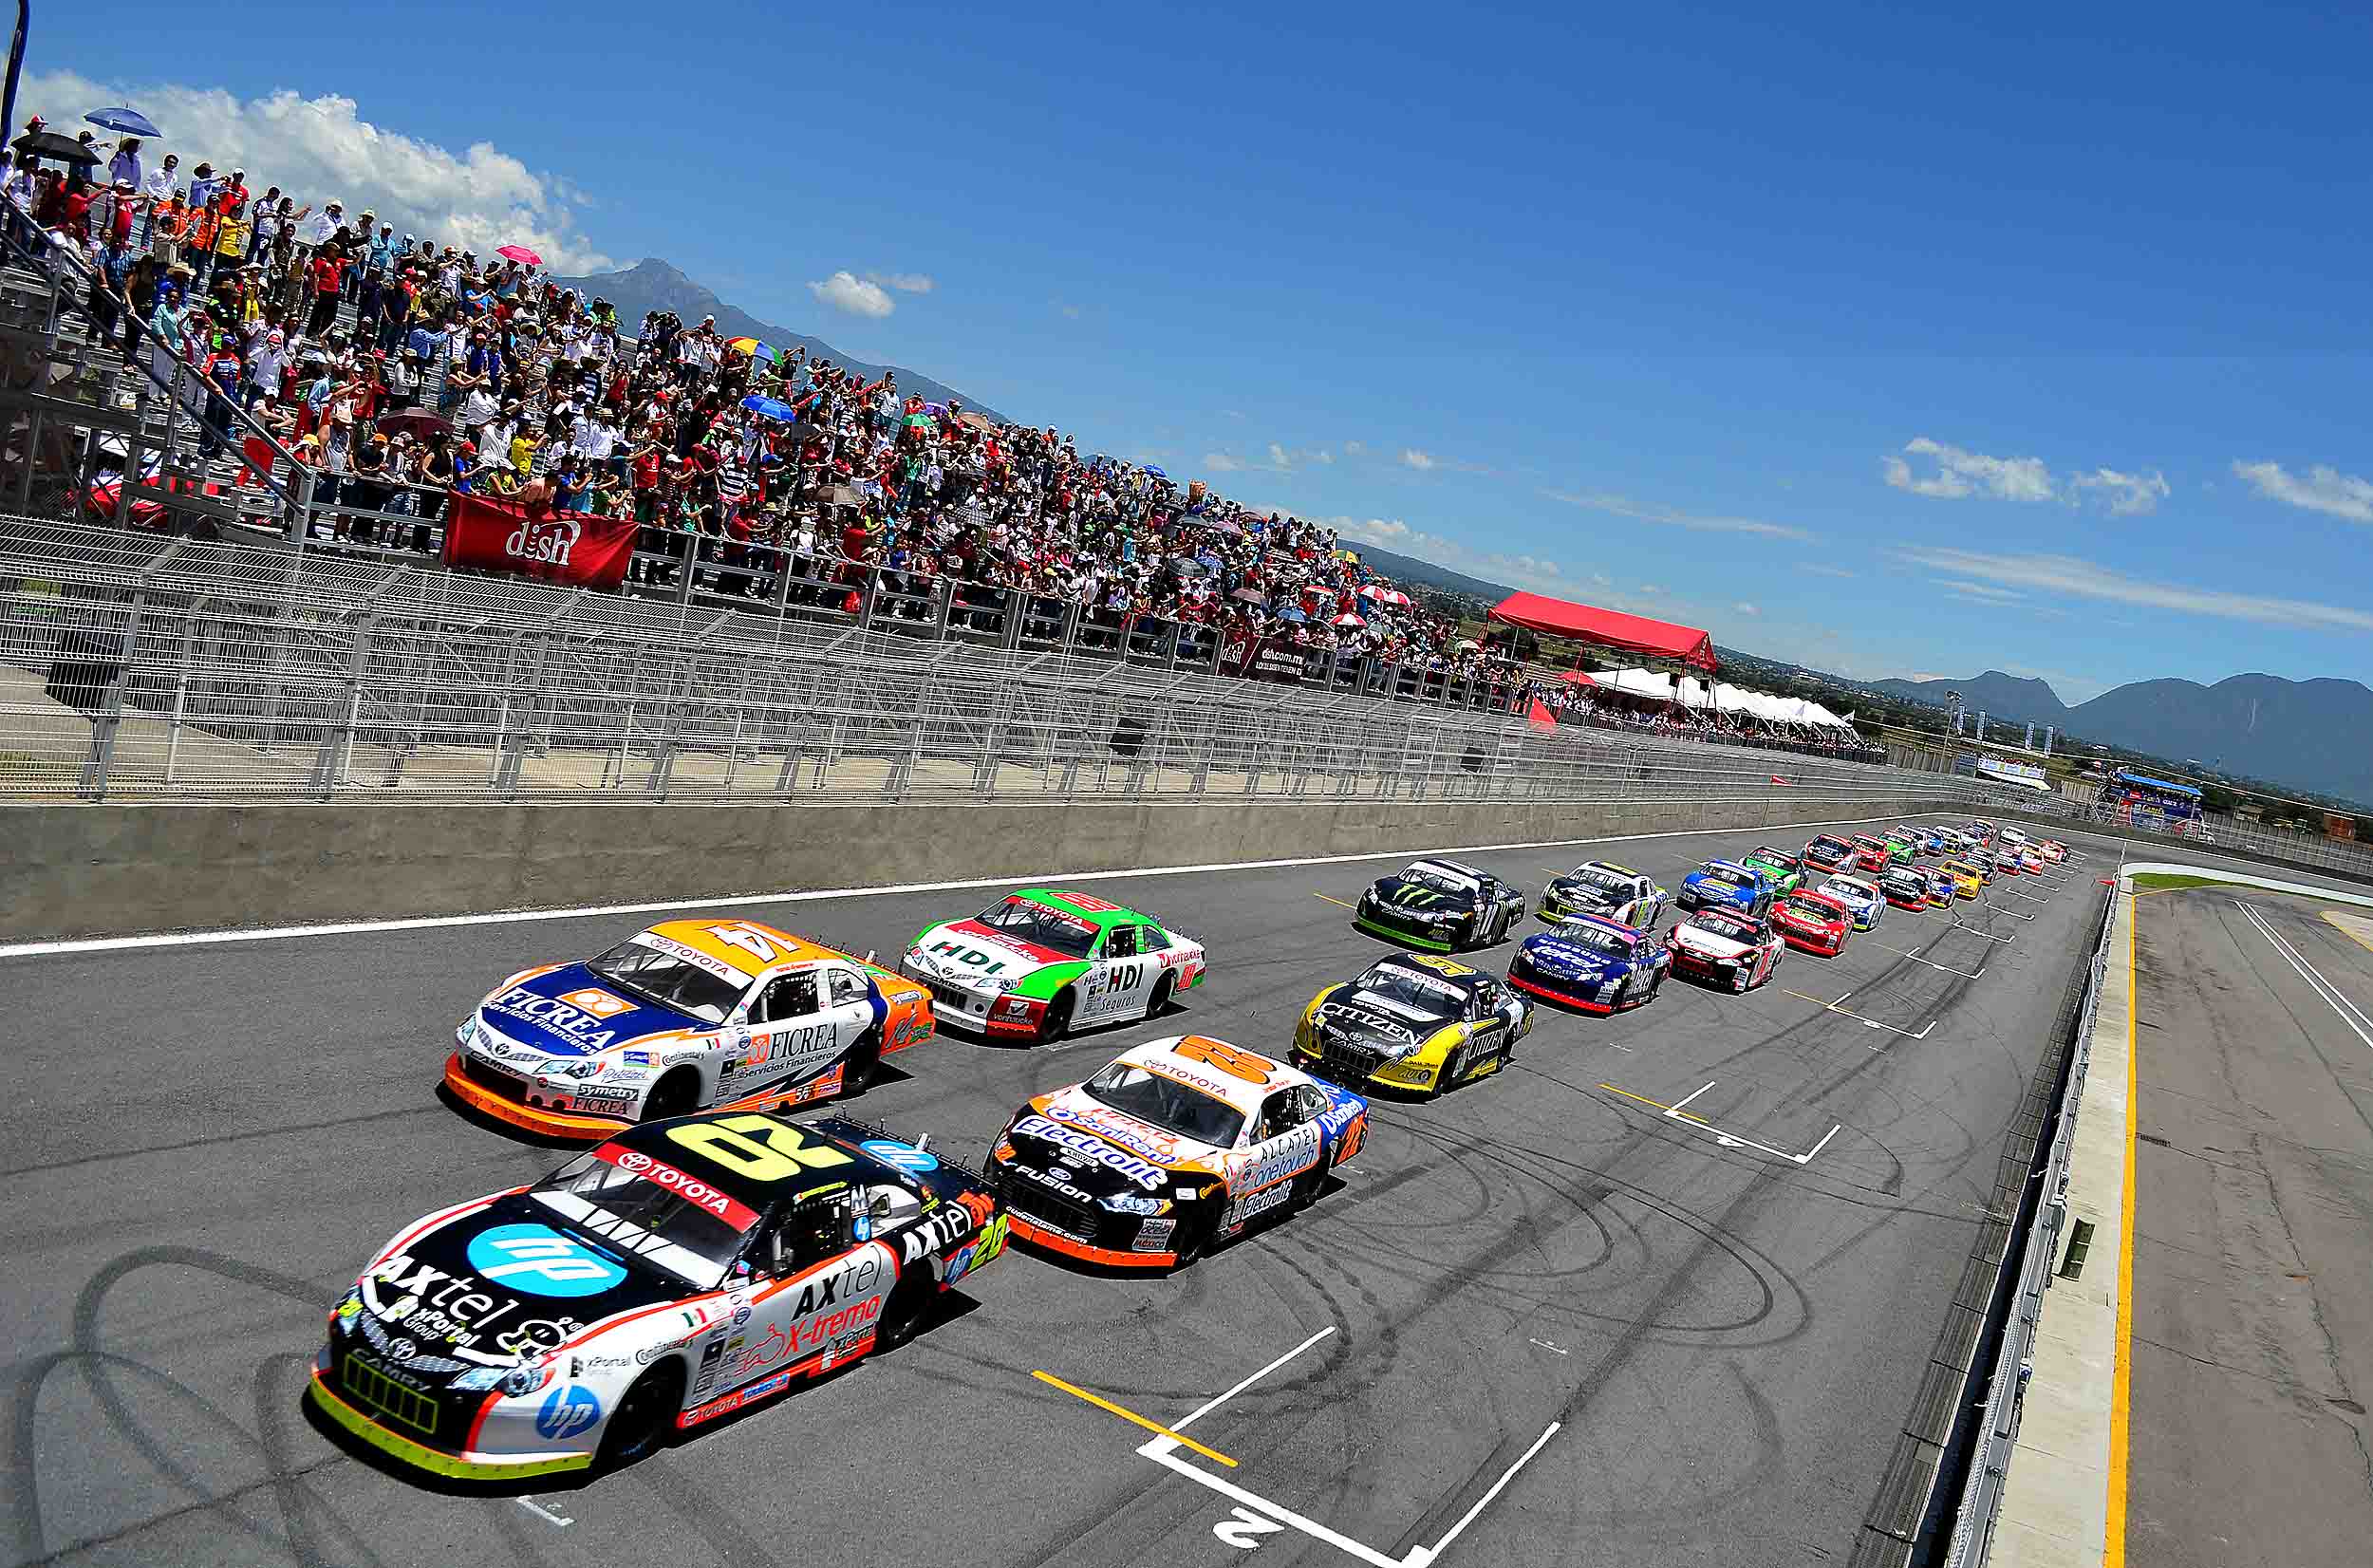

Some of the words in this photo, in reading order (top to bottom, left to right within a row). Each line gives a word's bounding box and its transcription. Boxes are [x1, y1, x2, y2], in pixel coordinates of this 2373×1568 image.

[505, 520, 582, 566] dish
[1037, 903, 1084, 925] TOYOTA
[670, 944, 730, 977] TOYOTA
[928, 941, 1007, 975] HDI
[1106, 963, 1145, 994] HDI
[1408, 970, 1452, 993] TOYOTA
[493, 985, 616, 1050] FICREA
[1100, 996, 1135, 1014] Seguros
[483, 1000, 538, 1025] Servicios
[533, 1017, 602, 1056] Financieros
[768, 1020, 838, 1061] FICREA
[1320, 1001, 1426, 1046] CITIZEN
[1329, 1036, 1375, 1055] CAMRY
[1467, 1027, 1509, 1061] CITIZEN
[743, 1062, 784, 1080] Servicios
[785, 1050, 837, 1071] Financieros
[1168, 1066, 1229, 1097] TOYOTA
[571, 1097, 628, 1115] FICREA
[580, 1084, 639, 1099] symetry
[665, 1114, 855, 1182] 20
[1013, 1116, 1168, 1190] Electrolit
[1261, 1128, 1318, 1164] ALCATEL
[1254, 1148, 1315, 1187] onetouch
[649, 1163, 731, 1216] TOYOTA
[967, 1213, 1009, 1272] 20
[542, 1384, 594, 1440] hp
[699, 1396, 738, 1419] TOYOTA
[1212, 1506, 1285, 1549] 2
